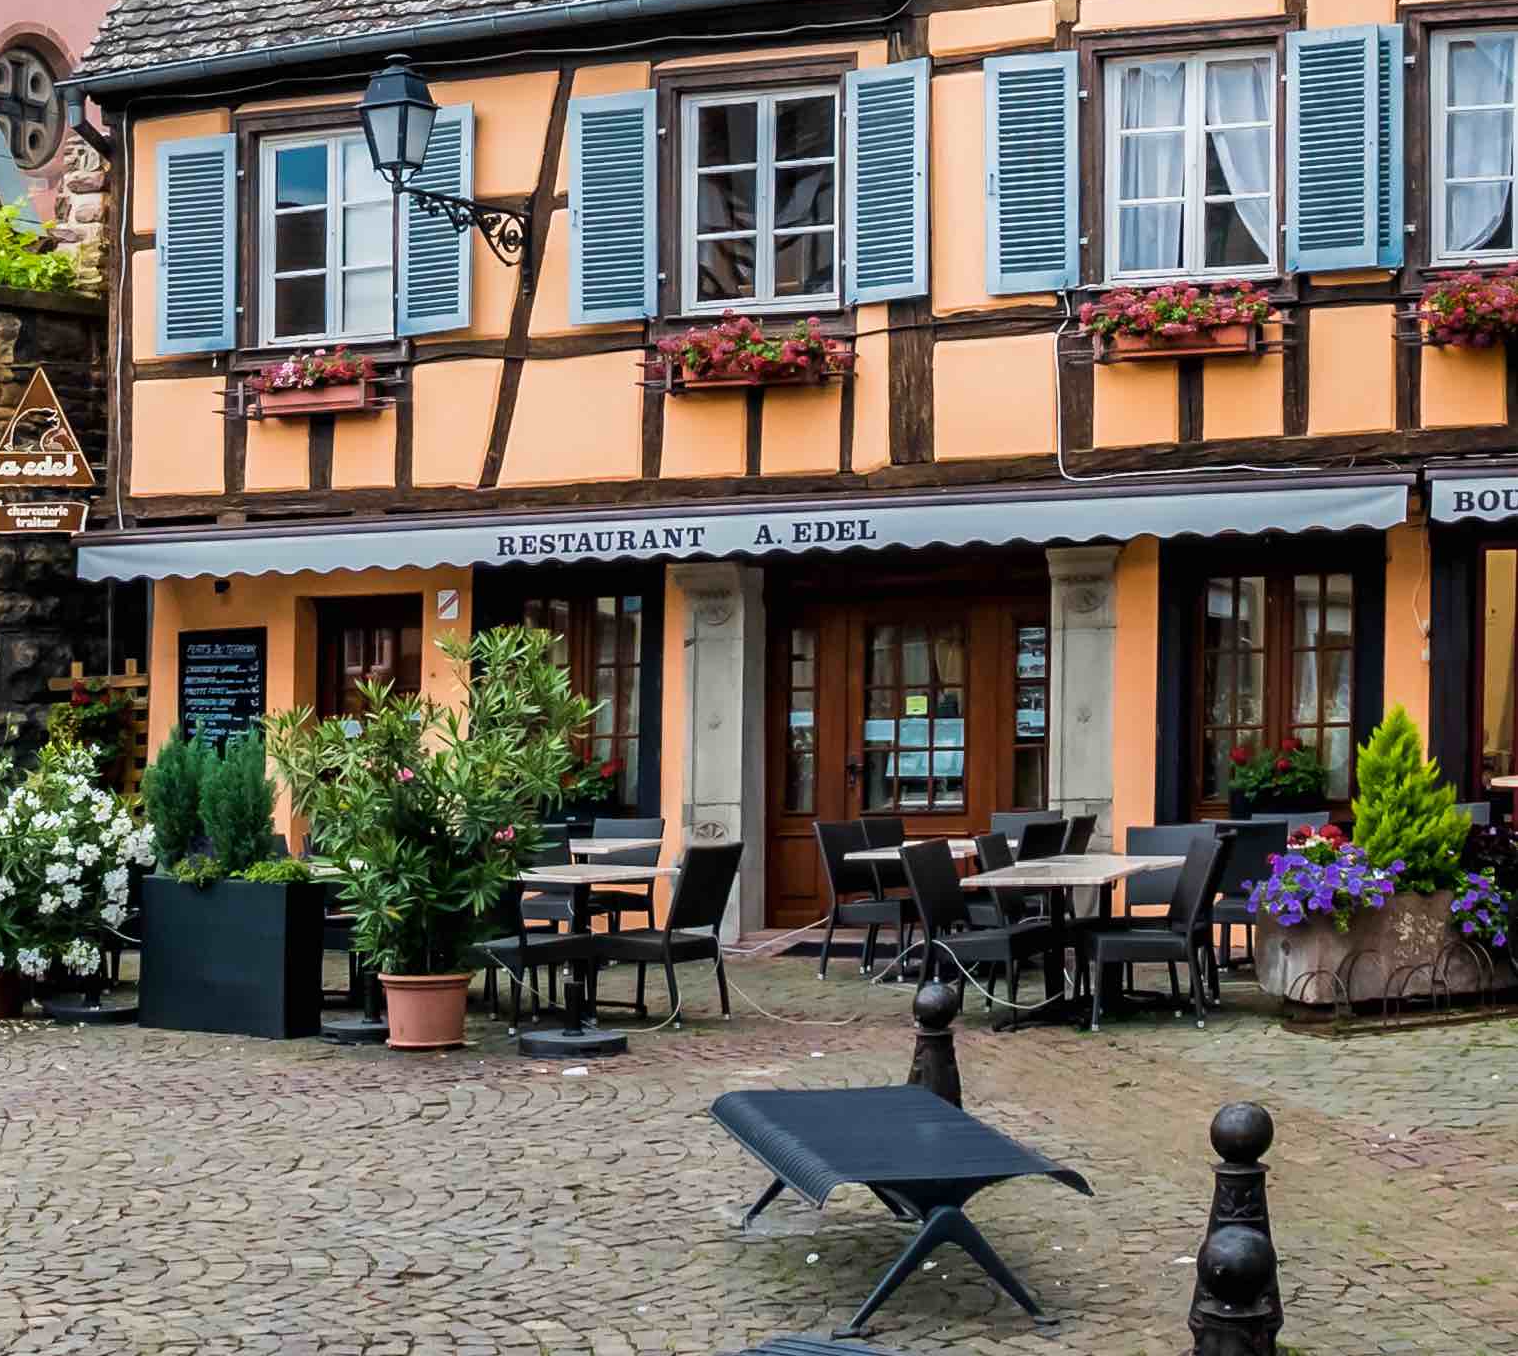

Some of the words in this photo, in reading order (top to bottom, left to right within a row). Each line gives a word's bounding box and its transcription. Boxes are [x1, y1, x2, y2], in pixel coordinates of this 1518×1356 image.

[22, 453, 78, 476] edel
[7, 506, 68, 517] charcuterie
[16, 517, 60, 528] traiteur
[496, 527, 705, 556] RESTAURANT
[754, 524, 782, 545] A.
[792, 519, 876, 543] EDEL
